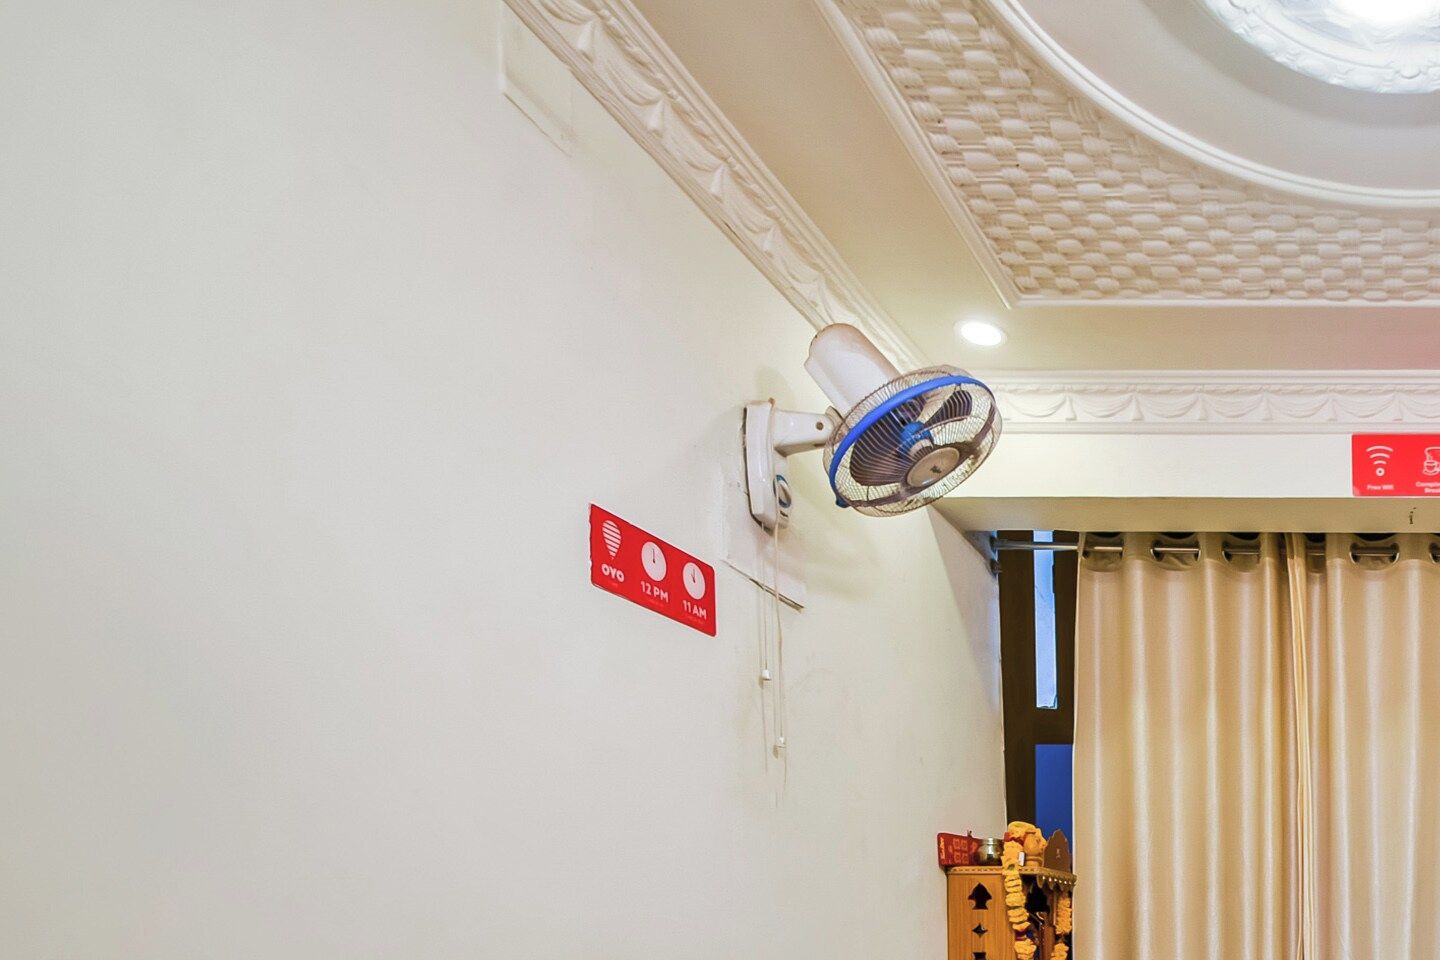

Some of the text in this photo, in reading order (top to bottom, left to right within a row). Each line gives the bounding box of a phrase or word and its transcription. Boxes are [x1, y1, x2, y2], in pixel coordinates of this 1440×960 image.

[601, 563, 625, 583] OYO
[640, 581, 651, 595] 12
[654, 586, 669, 603] PM
[683, 600, 691, 613] 11
[693, 605, 707, 620] AM
